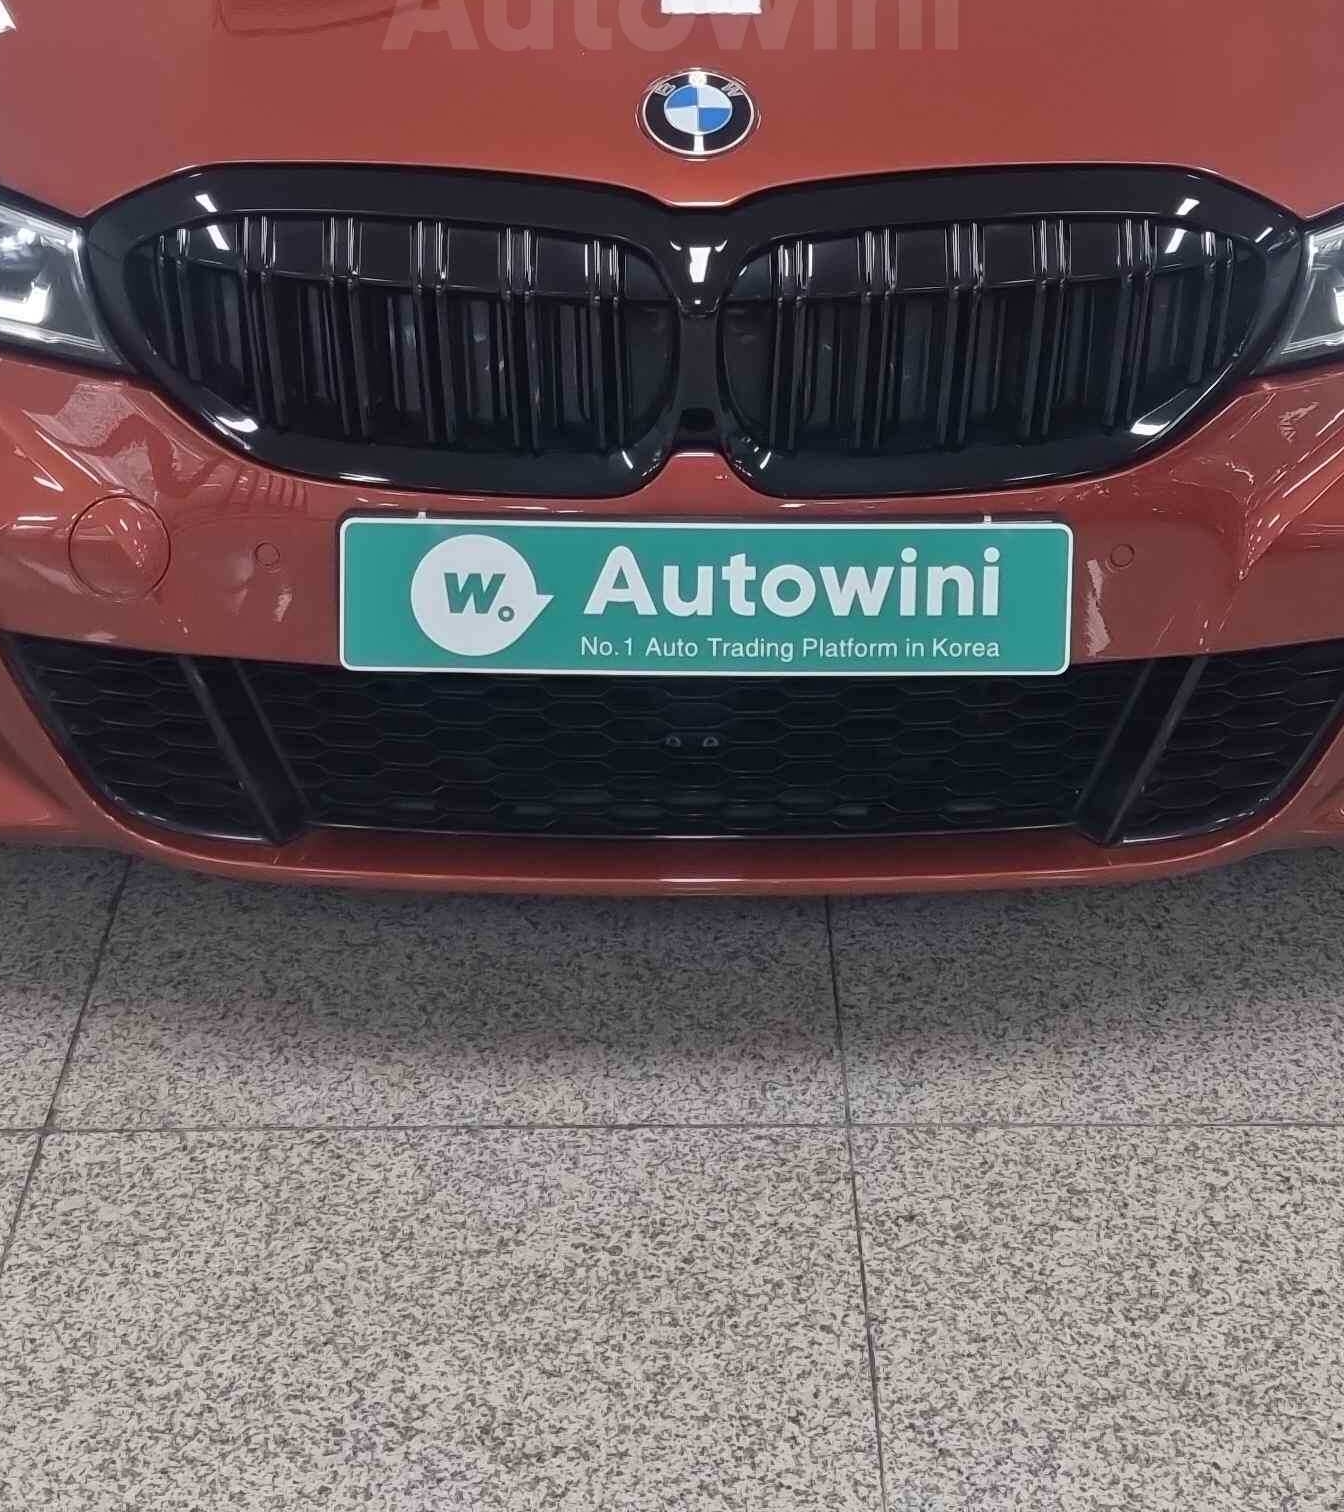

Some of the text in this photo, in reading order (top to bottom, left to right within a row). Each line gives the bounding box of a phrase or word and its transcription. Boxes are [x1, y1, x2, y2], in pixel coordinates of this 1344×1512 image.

[583, 545, 1000, 618] Autowini
[645, 638, 698, 657] Auto
[707, 638, 794, 663] Trading
[803, 638, 898, 657] Platform
[906, 638, 925, 657] in
[932, 638, 1000, 657] Korea
